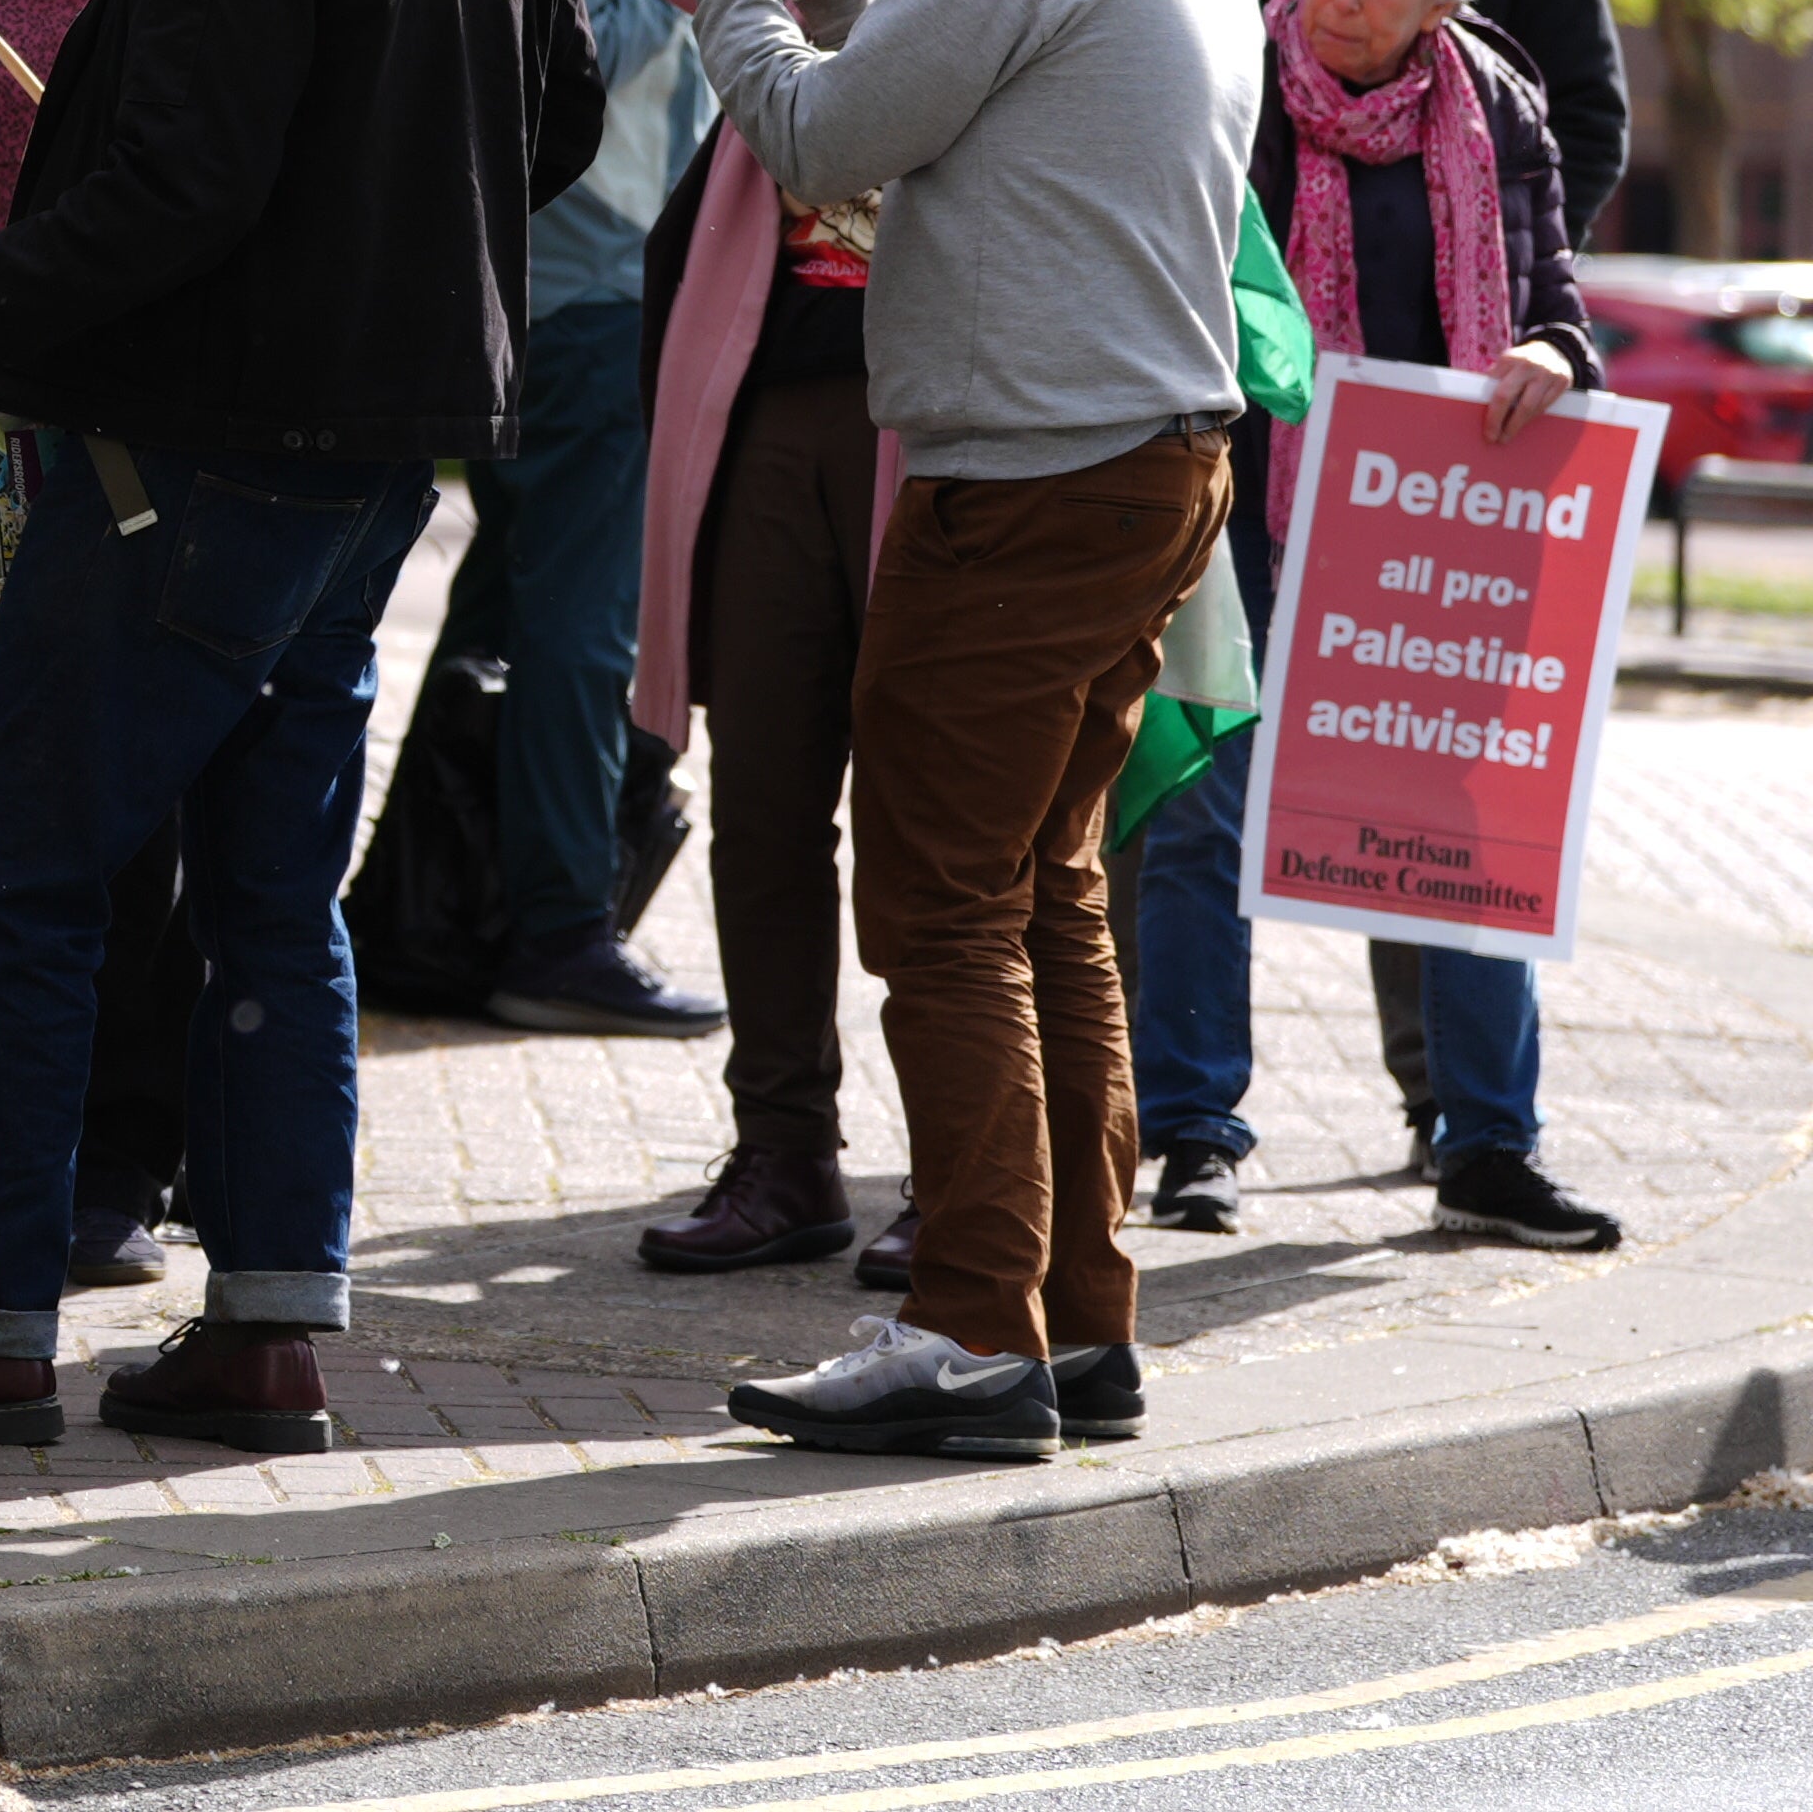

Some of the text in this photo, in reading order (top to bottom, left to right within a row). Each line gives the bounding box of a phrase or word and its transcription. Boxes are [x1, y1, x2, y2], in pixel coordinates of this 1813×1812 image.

[1349, 449, 1591, 540] Defend
[1379, 555, 1529, 608] all pro-
[1317, 613, 1566, 694] Palestine
[1307, 699, 1552, 769] activists!
[1280, 847, 1542, 914] Defence Committee
[1358, 826, 1471, 869] Partisan
